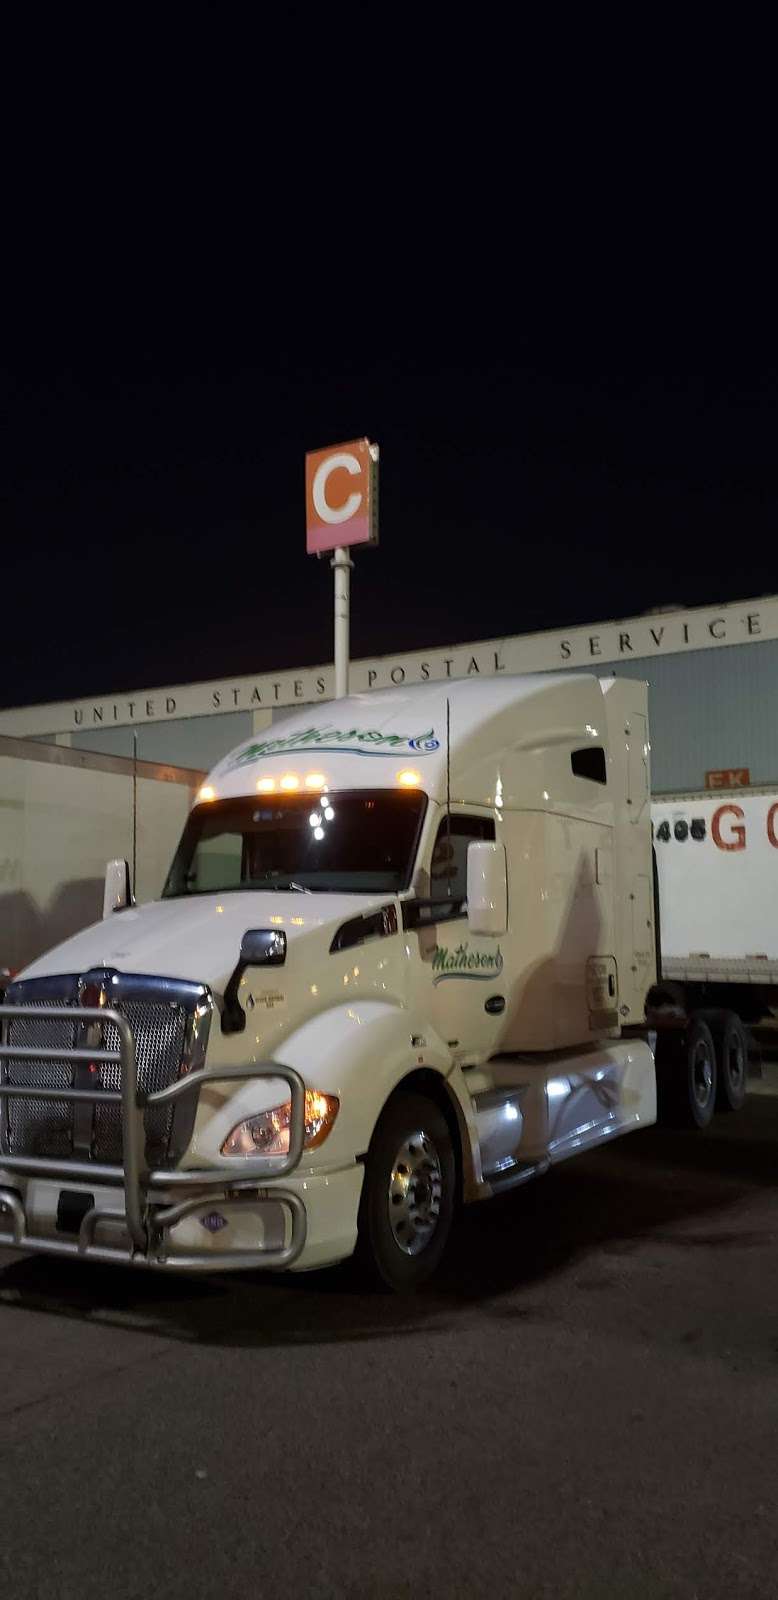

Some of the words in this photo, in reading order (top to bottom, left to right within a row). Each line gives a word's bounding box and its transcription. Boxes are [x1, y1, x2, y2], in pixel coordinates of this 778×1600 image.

[313, 452, 362, 525] C
[74, 697, 177, 725] UNITED
[212, 677, 326, 708] STATES
[367, 651, 506, 688] POSTAL
[560, 614, 763, 660] SERVICE
